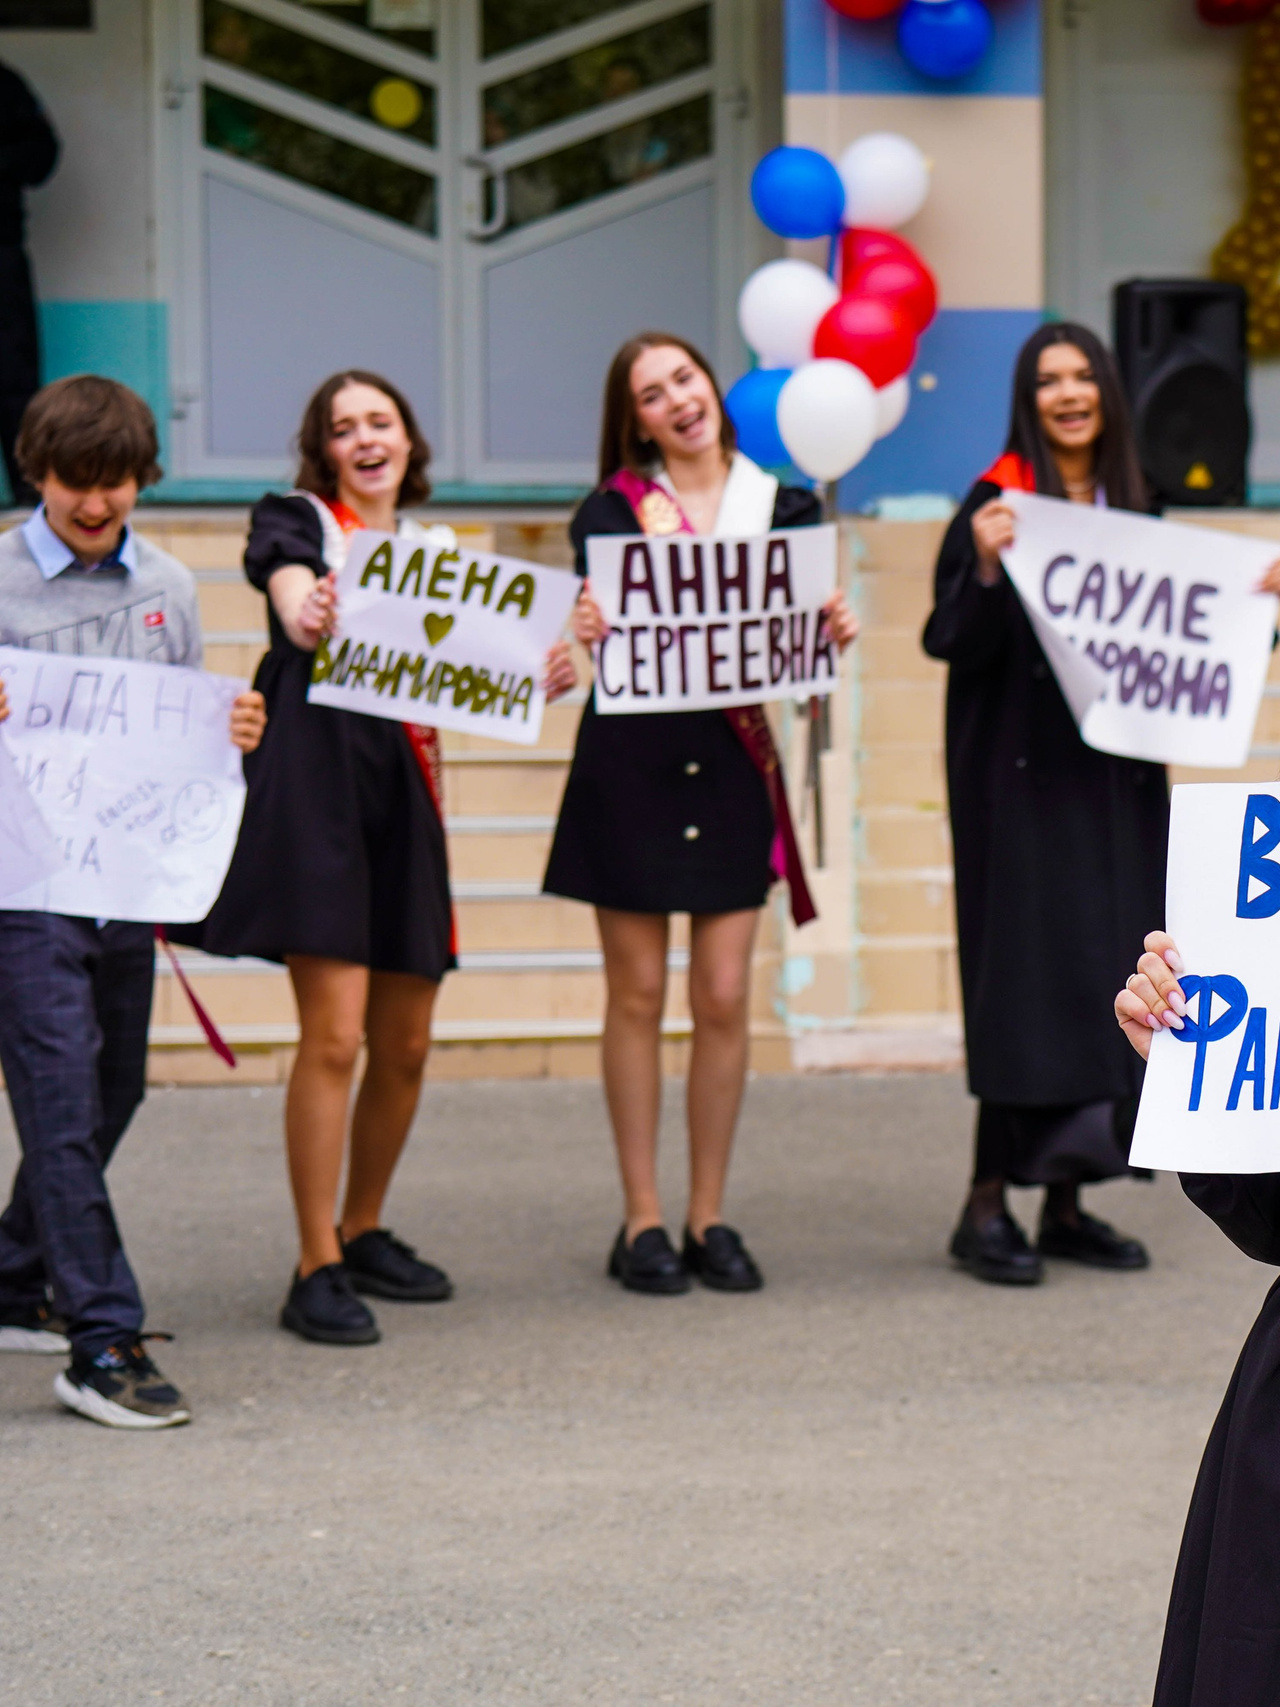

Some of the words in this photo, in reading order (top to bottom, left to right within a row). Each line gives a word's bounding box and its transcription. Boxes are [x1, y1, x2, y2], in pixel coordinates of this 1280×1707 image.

[620, 538, 793, 616] АННА
[1042, 554, 1218, 643] САУЛЕ
[600, 609, 834, 697] СЕРГЕЕВНА
